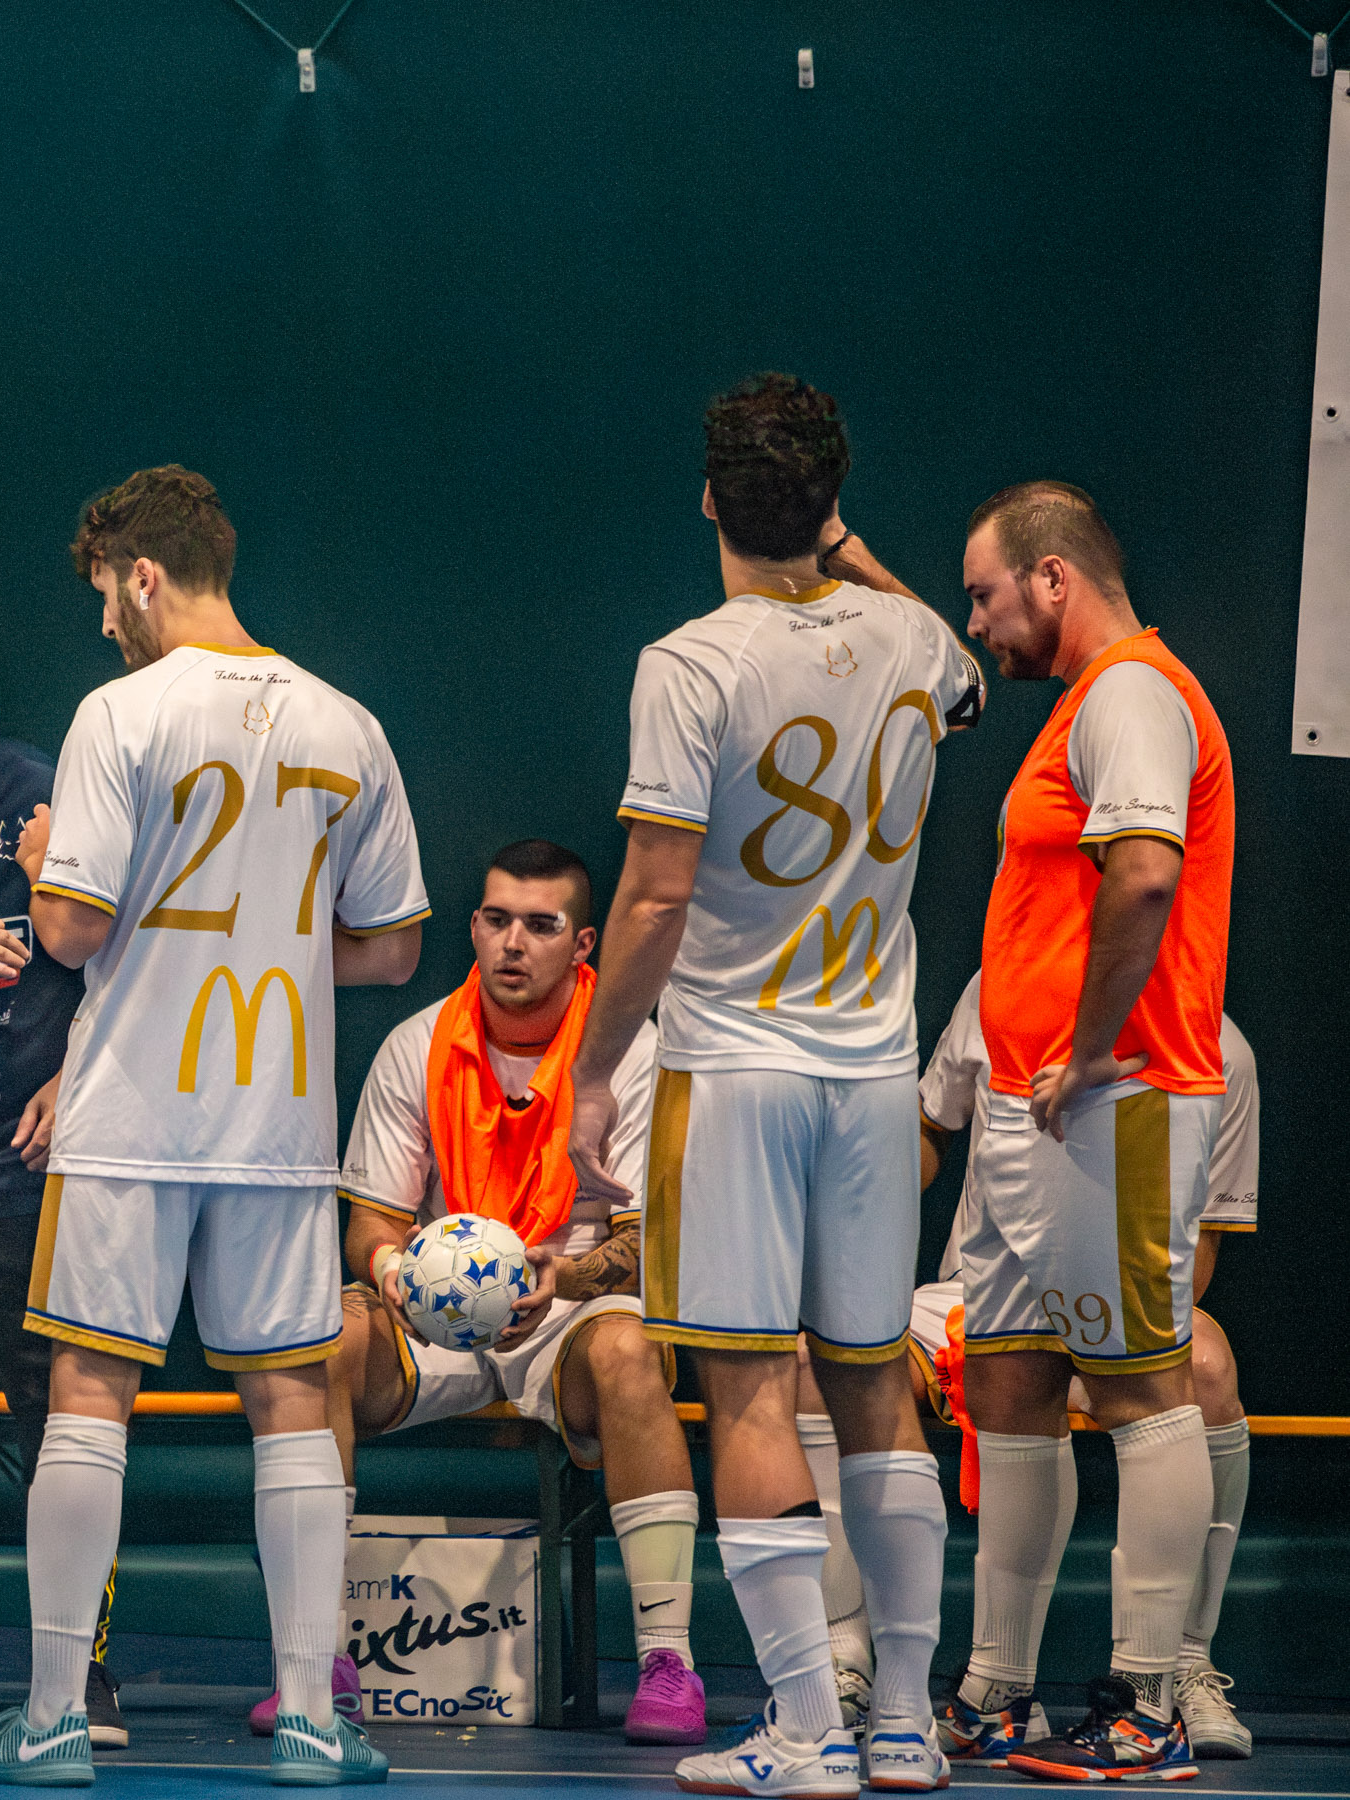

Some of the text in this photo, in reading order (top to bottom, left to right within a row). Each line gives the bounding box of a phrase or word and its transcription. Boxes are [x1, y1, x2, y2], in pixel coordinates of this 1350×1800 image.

[214, 670, 291, 684] Follow the Foxes
[740, 689, 942, 887] 80
[139, 760, 361, 938] 27
[1041, 1289, 1112, 1346] 69
[347, 1602, 527, 1675] ixtus.it
